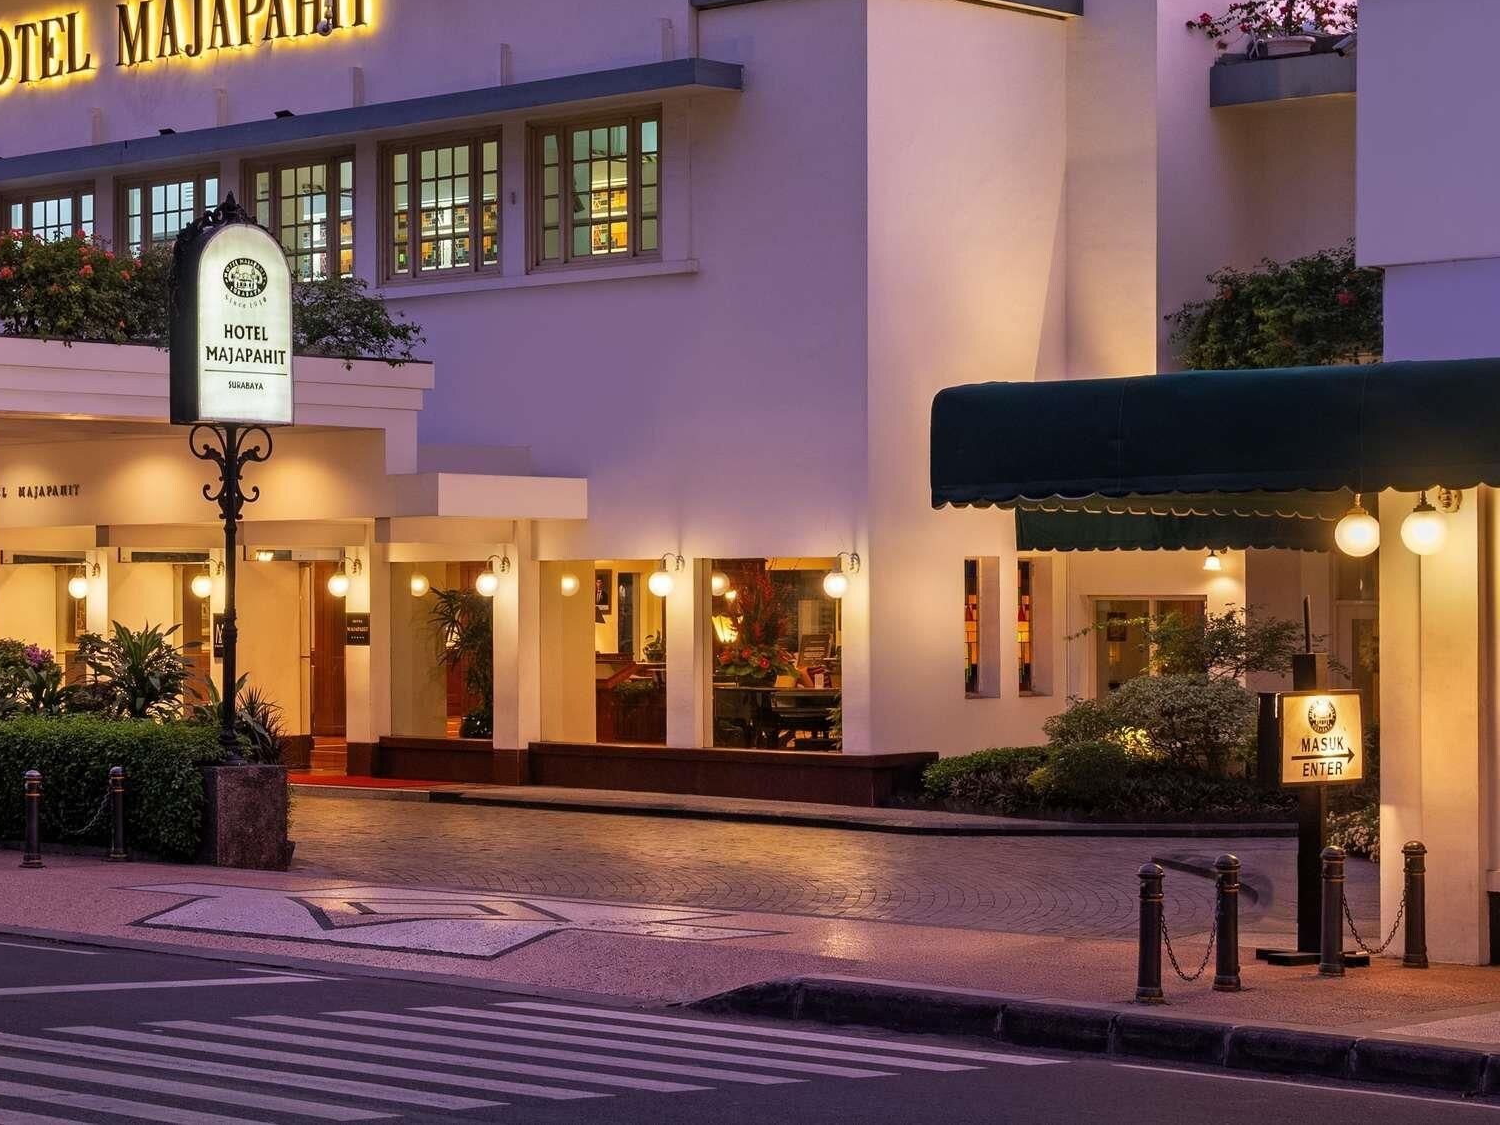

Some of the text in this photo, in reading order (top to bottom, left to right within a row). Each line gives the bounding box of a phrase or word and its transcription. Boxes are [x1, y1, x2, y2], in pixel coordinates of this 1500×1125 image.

[224, 324, 269, 341] HOTEL
[205, 345, 286, 365] MAJAPAHIT
[228, 380, 264, 390] SURABAYA
[18, 483, 80, 500] MAJAPAHIT
[1301, 737, 1344, 752] MASUK
[1302, 761, 1343, 777] ENTER
